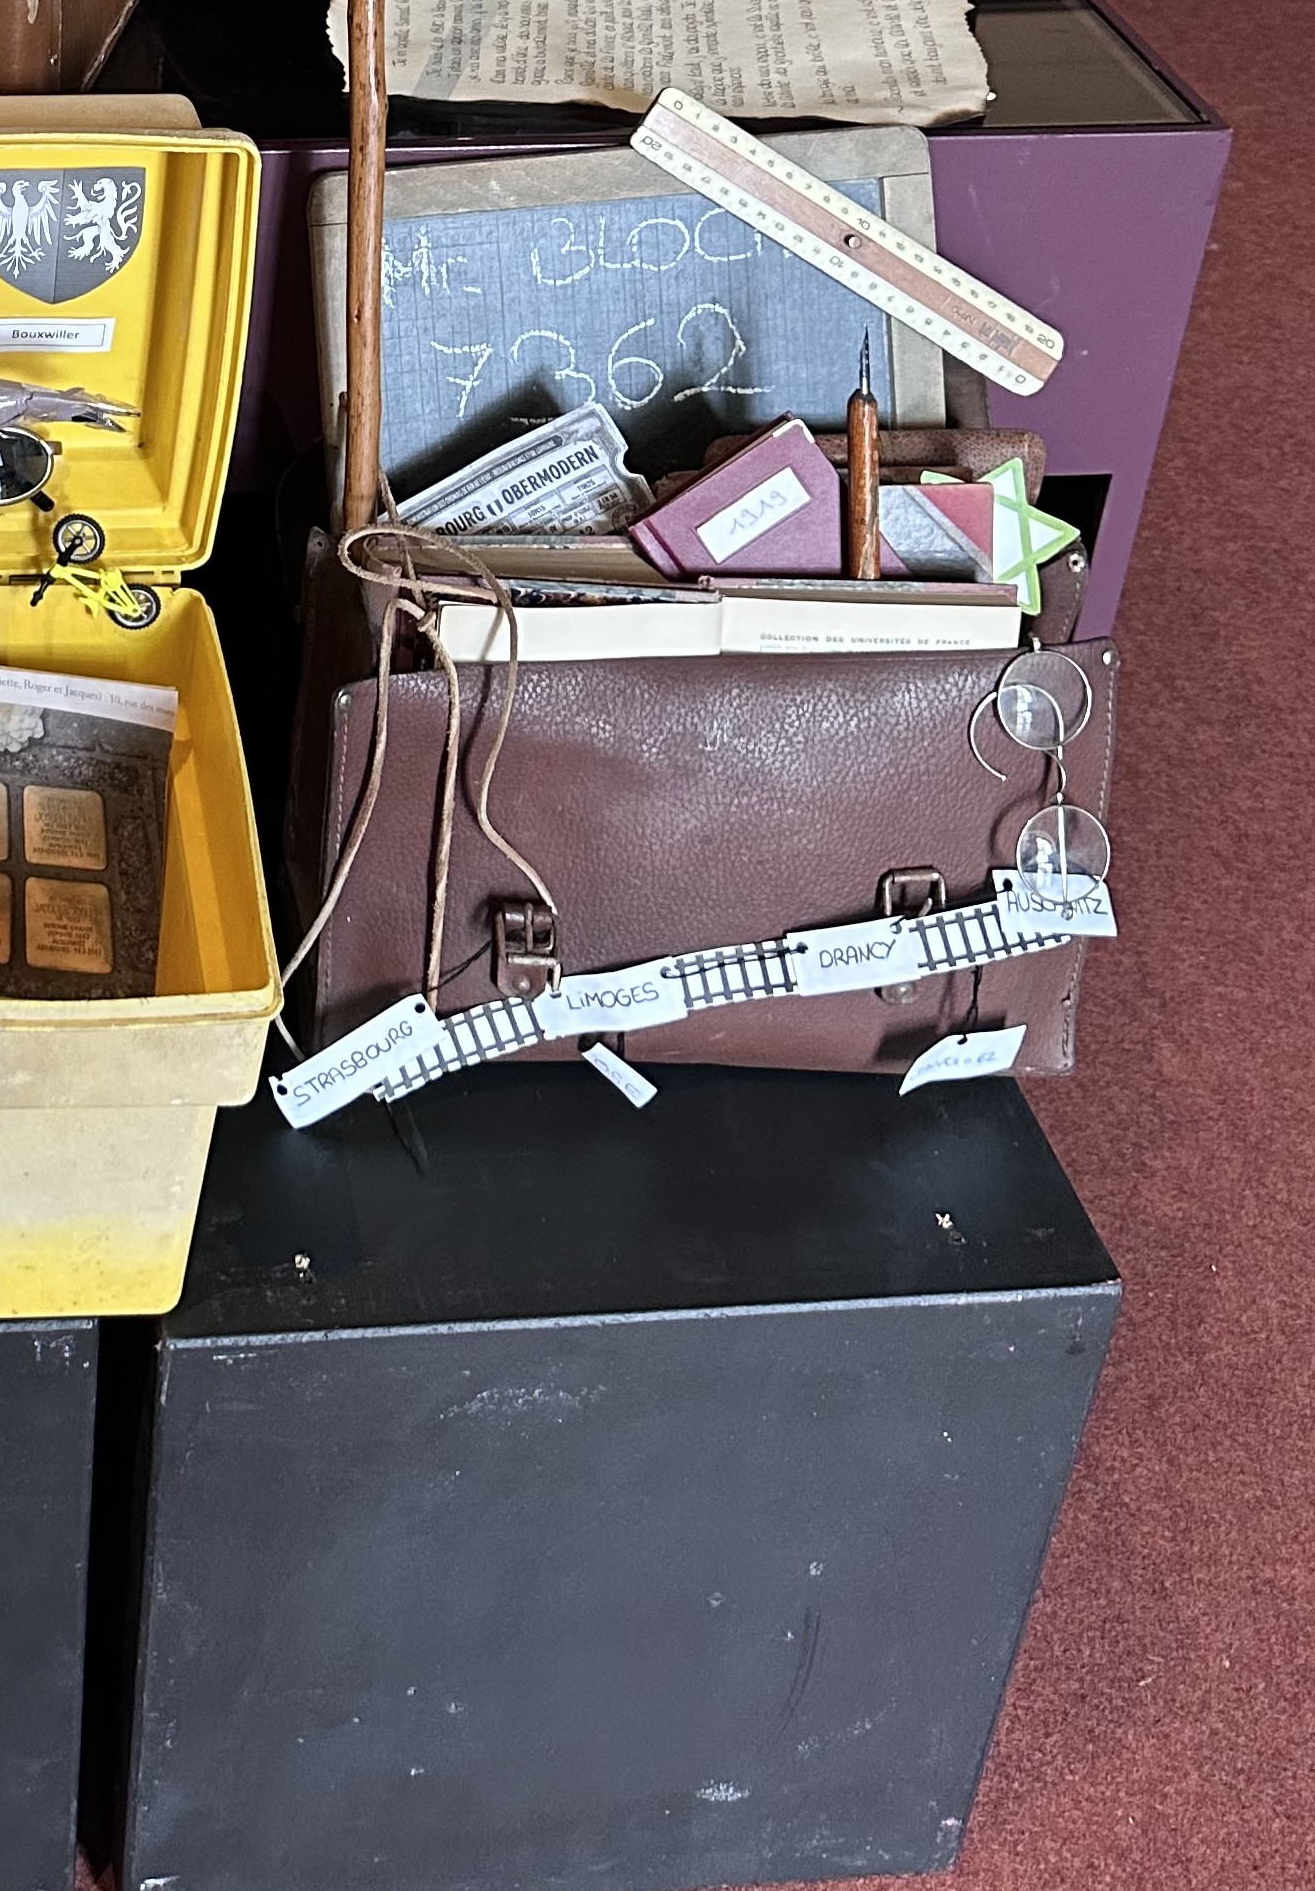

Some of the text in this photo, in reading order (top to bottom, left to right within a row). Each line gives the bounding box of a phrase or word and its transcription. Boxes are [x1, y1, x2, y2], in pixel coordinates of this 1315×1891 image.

[12, 329, 80, 339] Bouxwiller
[430, 301, 776, 419] 7362
[501, 445, 600, 505] OBERMODERN
[760, 633, 820, 642] COLLECTION
[935, 638, 971, 646] FRANCE
[1007, 891, 1108, 916] AUSCHITZ
[819, 939, 897, 969] DRANCY
[293, 1020, 414, 1106] STRASBOURG
